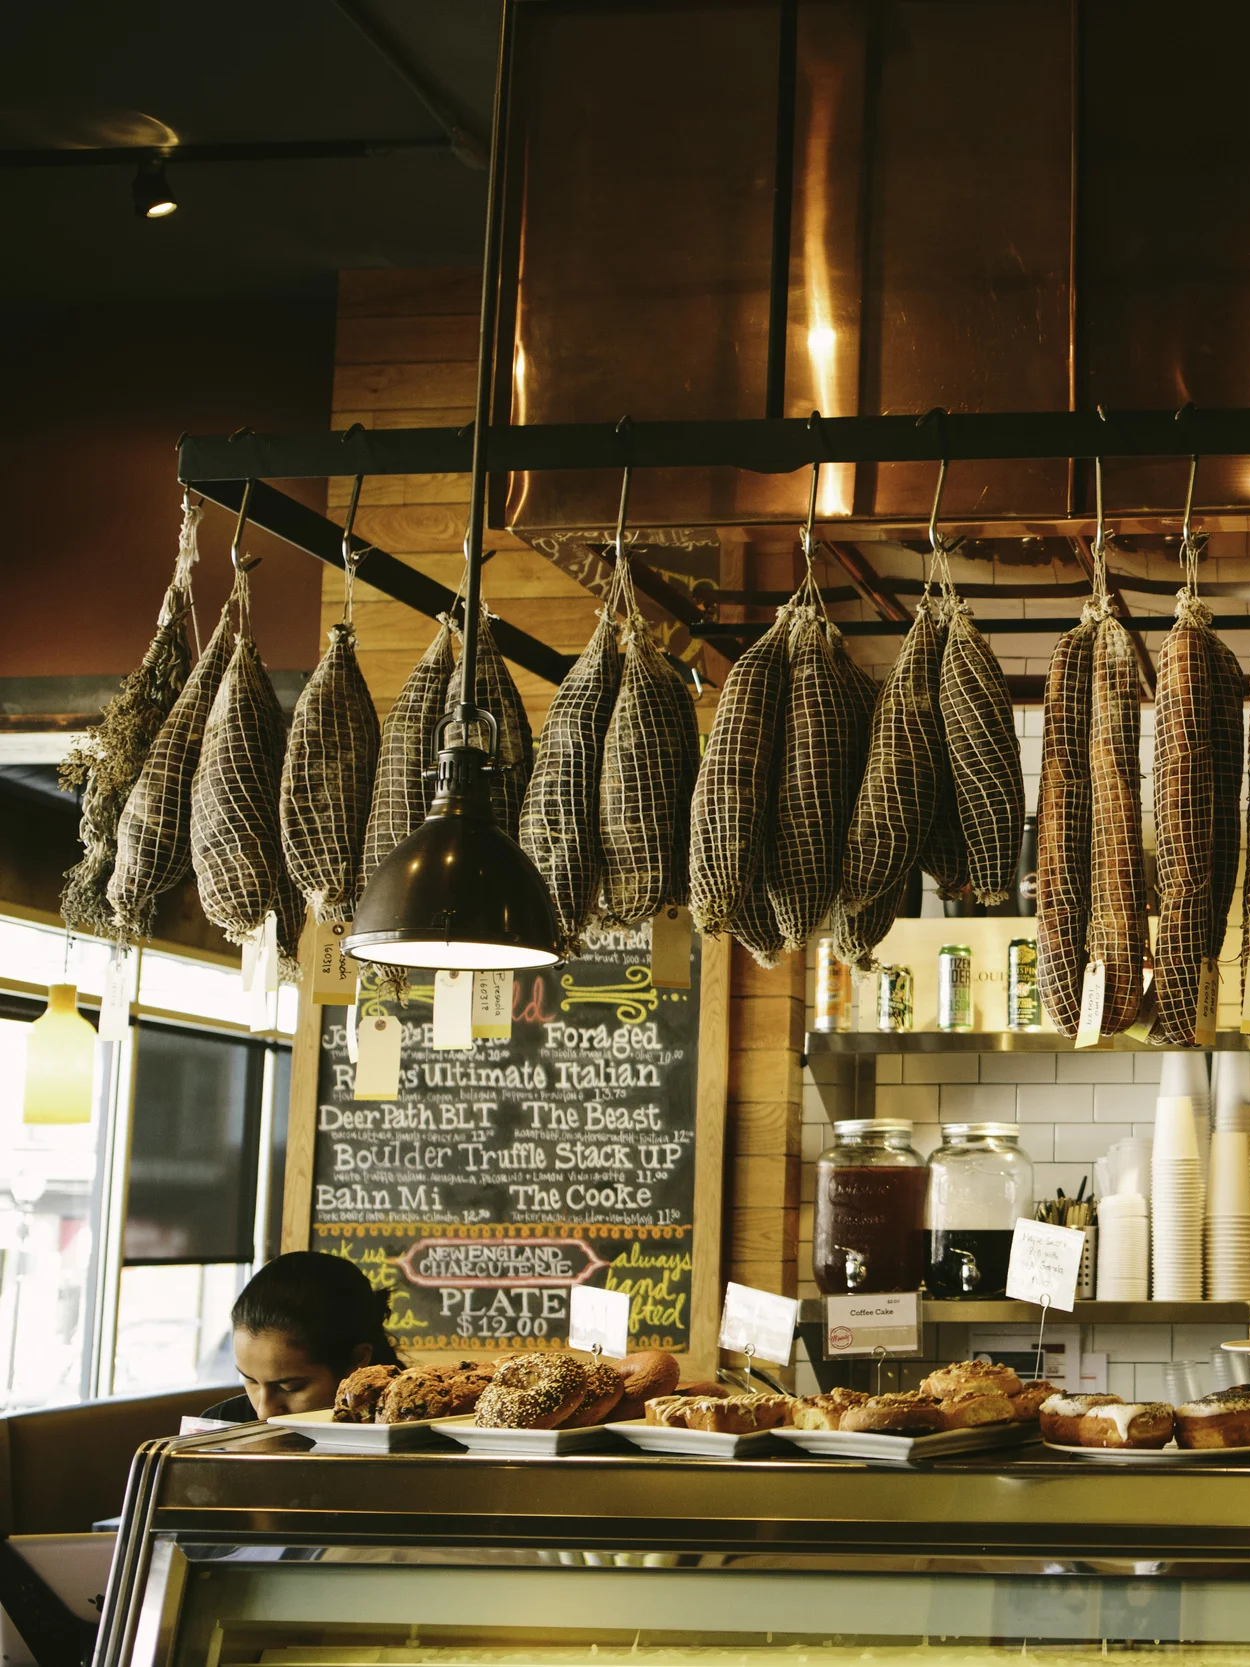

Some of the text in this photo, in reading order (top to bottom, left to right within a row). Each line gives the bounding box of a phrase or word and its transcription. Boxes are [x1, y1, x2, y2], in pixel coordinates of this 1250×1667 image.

[543, 1022, 663, 1059] Foraged
[422, 1060, 547, 1090] Ultimate
[555, 1059, 661, 1090] Italian
[318, 1102, 498, 1131] Deer Path BLT
[522, 1102, 662, 1131] The Beast
[334, 1141, 682, 1171] Boulder Truffle Stack UP
[316, 1184, 443, 1211] Bahn Mi
[509, 1183, 652, 1211] The Cooke
[428, 1245, 563, 1262] NEW ENGLAND
[610, 1242, 692, 1281] always
[419, 1260, 573, 1278] CHARCUTERIE
[439, 1287, 568, 1318] PLATE
[629, 1292, 687, 1334] fted
[850, 1308, 894, 1317] Coffee Cake
